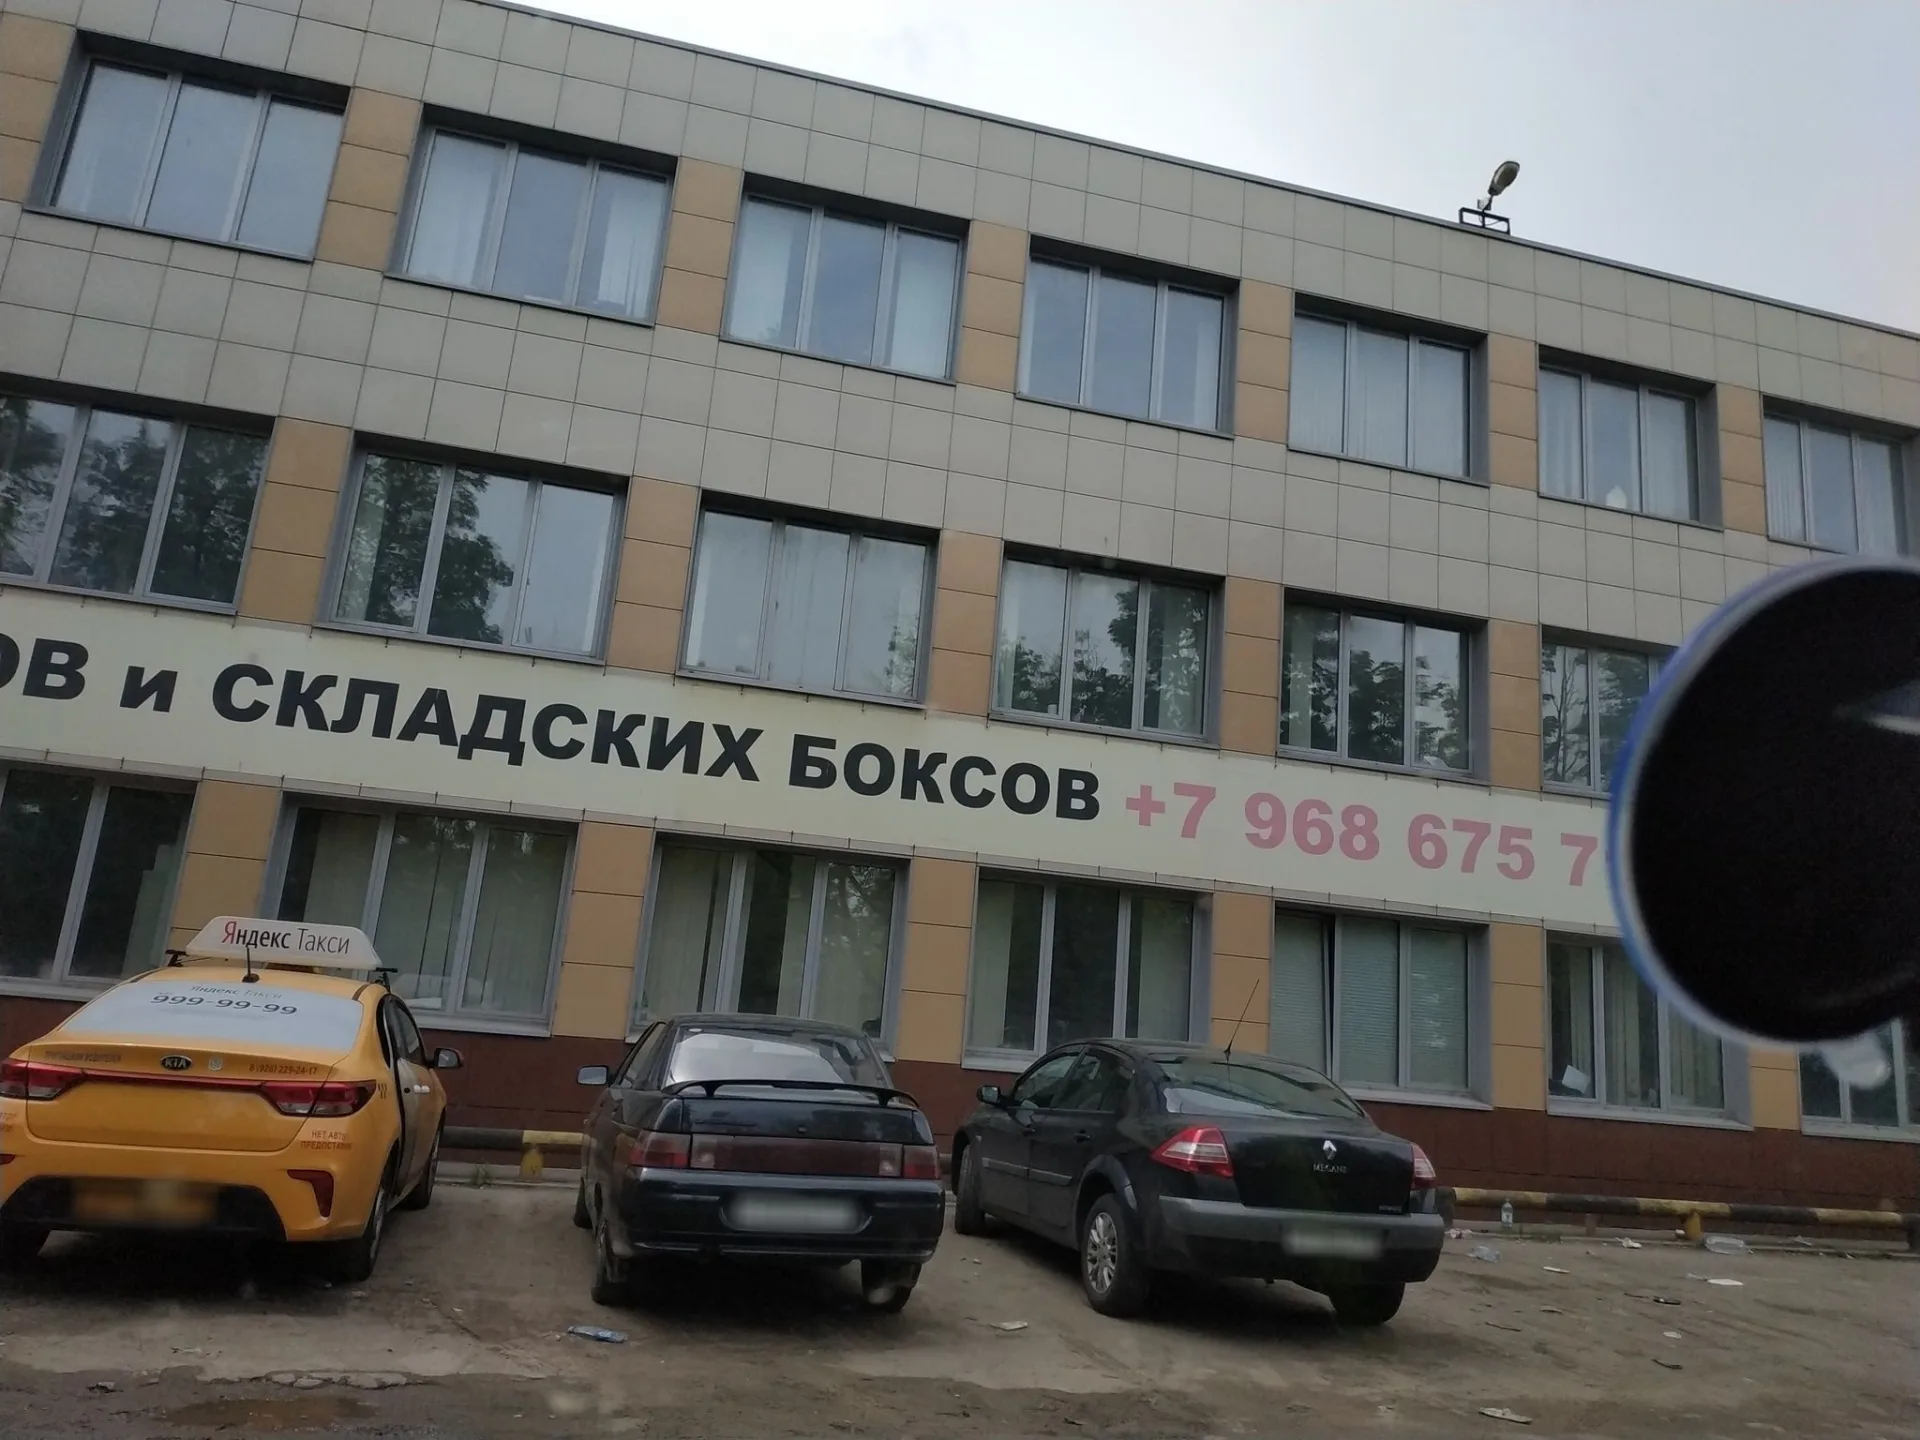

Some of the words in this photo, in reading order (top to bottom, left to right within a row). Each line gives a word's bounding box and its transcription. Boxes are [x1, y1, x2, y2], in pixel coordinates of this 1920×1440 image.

[119, 666, 179, 713] и
[212, 663, 765, 782] СКЛАДСКИХ
[788, 733, 1100, 821] БОКСОВ
[1125, 782, 1216, 839] +7
[1244, 792, 1380, 861] 968
[1407, 813, 1536, 881] 675
[1560, 832, 1608, 887] 7
[222, 921, 292, 949] Яндекс
[297, 928, 350, 954] Такси
[151, 995, 298, 1015] 999-99-99
[165, 1057, 187, 1068] KIA
[311, 1130, 327, 1138] НЕТ
